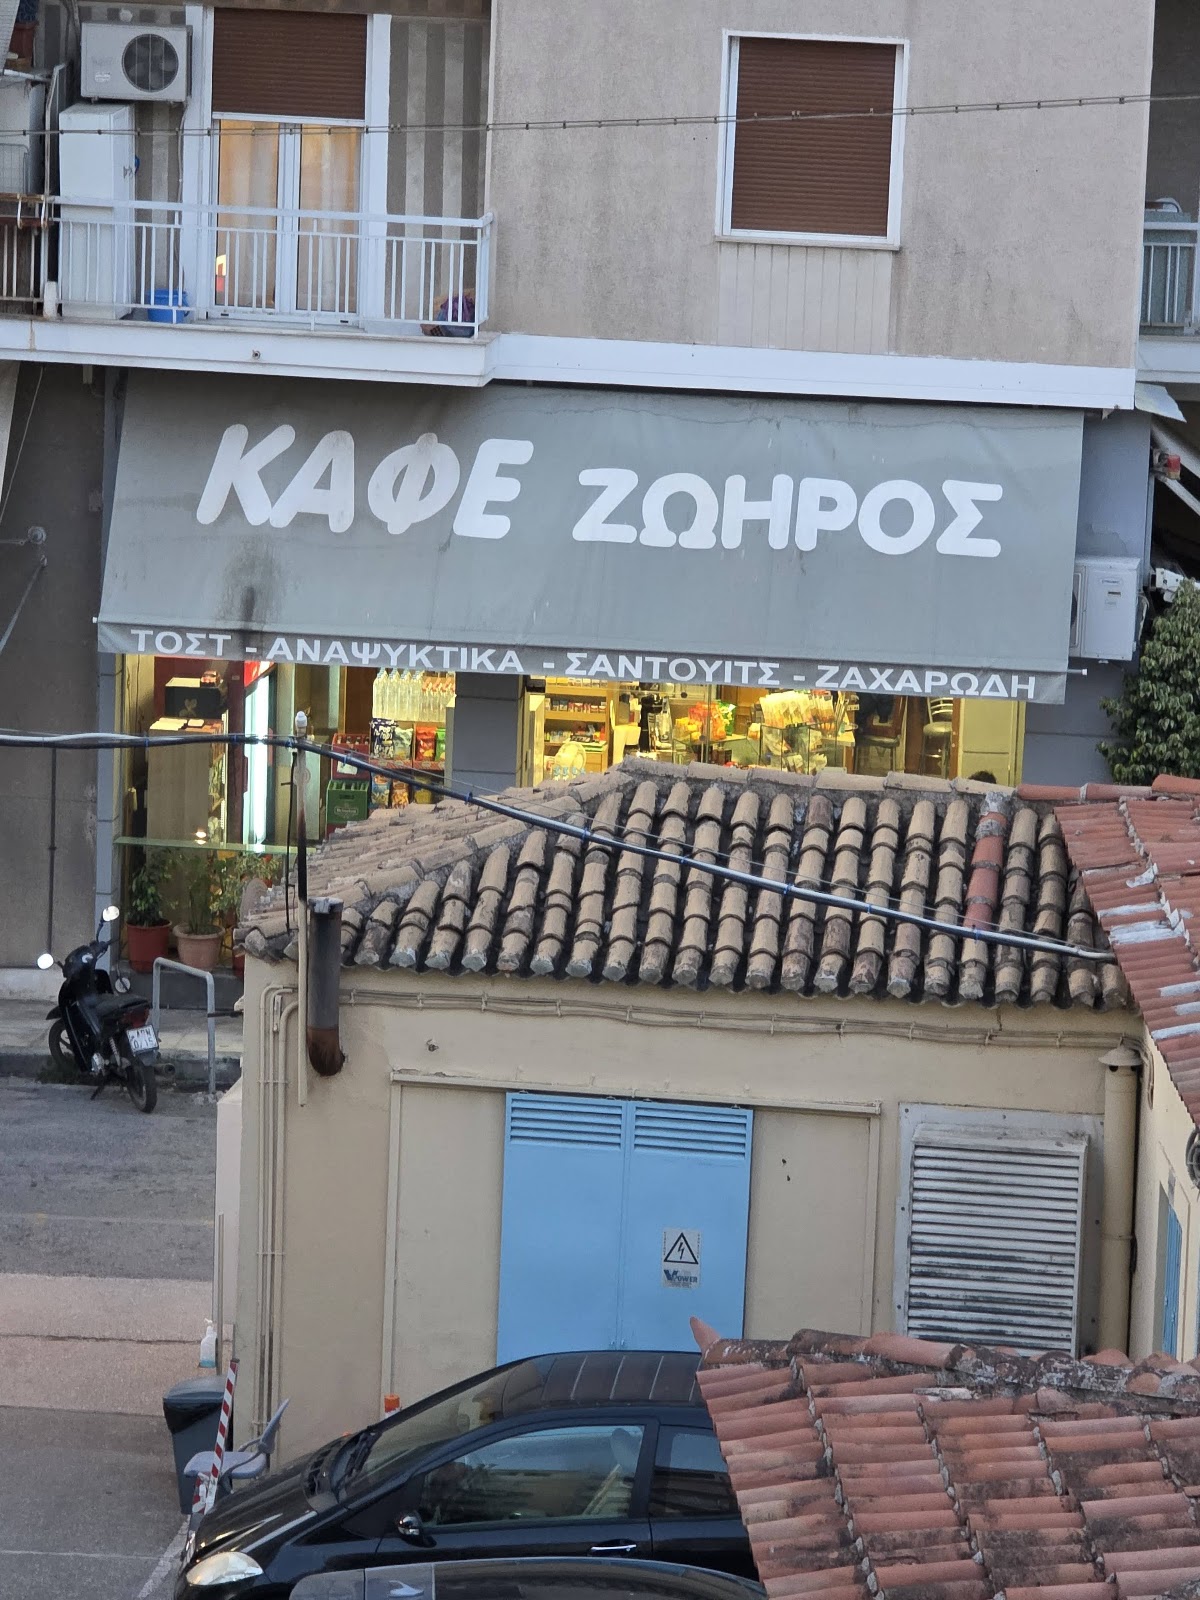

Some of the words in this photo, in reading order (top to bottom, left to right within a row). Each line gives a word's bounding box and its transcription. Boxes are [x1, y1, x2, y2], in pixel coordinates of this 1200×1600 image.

[196, 424, 534, 540] ΚΑΦΕ
[572, 468, 1003, 558] ΖΩΗΡΟΣ
[131, 629, 231, 656] ΤΟΣΤ
[266, 637, 524, 673] ΑΝΑΨΥΚΤΙΚΑ
[565, 652, 780, 686] ΣΑΝΤΟΥΙΤΣ
[814, 664, 1036, 699] ΖΑΧΑΡΩΔΗ
